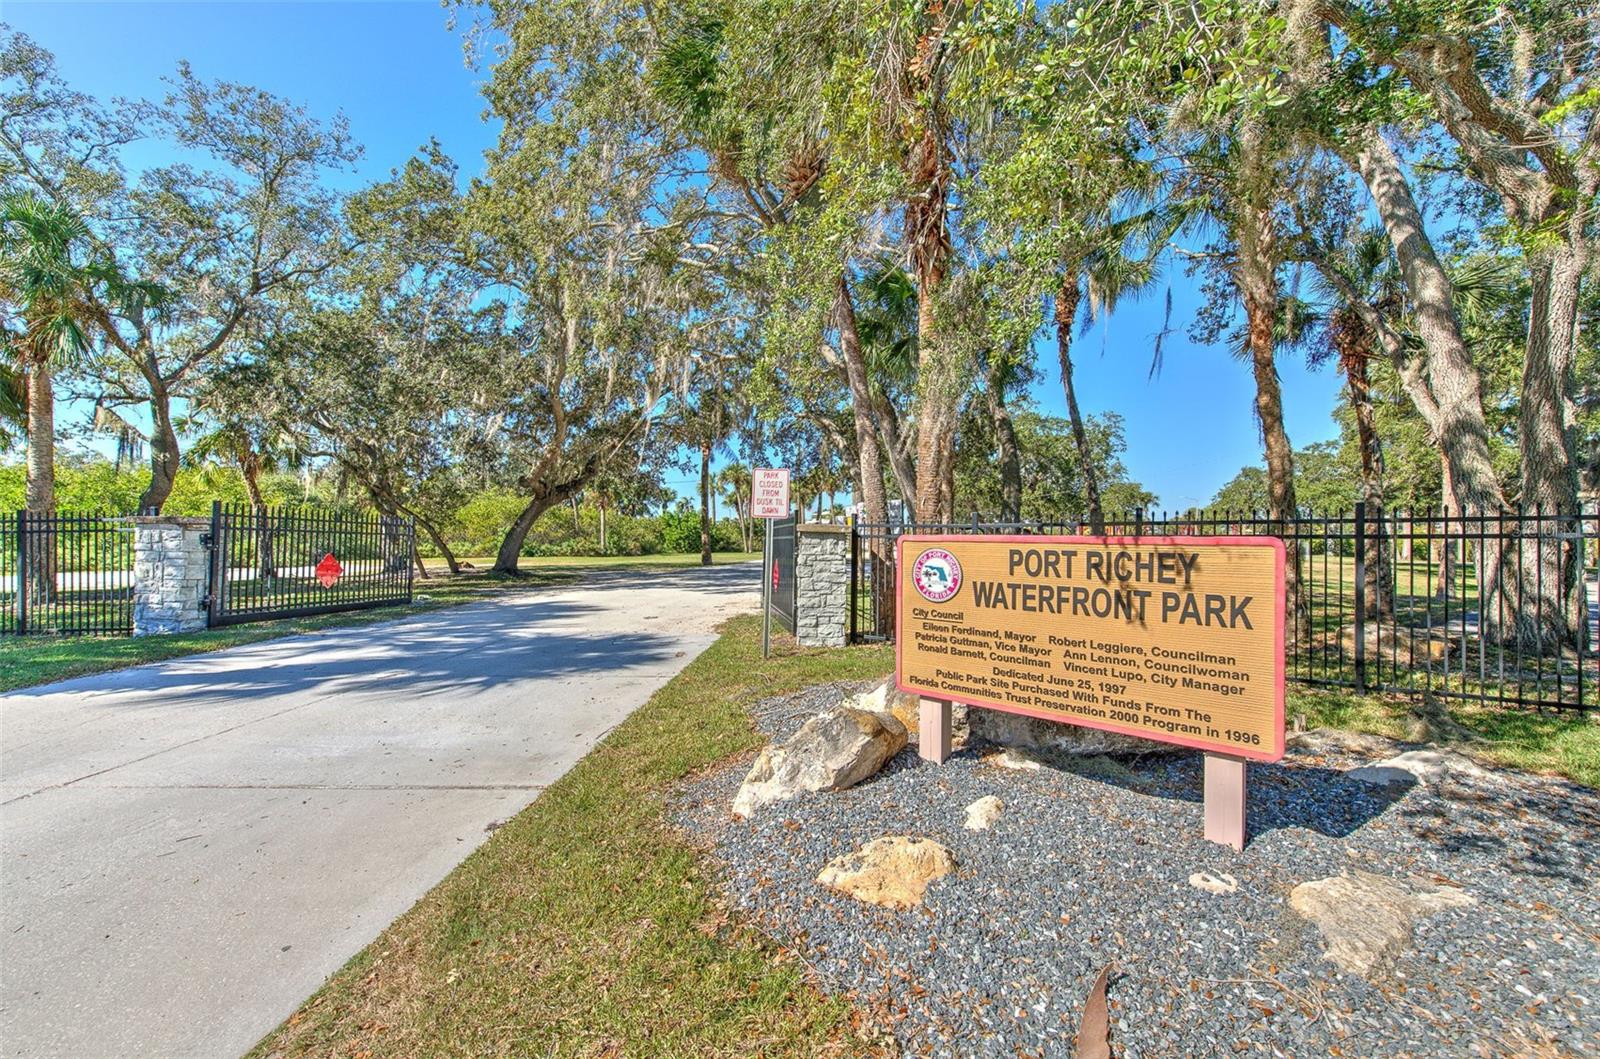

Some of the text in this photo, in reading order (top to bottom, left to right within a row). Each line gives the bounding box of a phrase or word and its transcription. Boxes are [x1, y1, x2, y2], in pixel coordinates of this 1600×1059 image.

[756, 498, 773, 506] DUSK
[762, 506, 779, 514] DAWN
[1008, 549, 1199, 584] PORT RICHEY
[922, 588, 951, 600] FLORIDA
[972, 580, 1254, 630] WATERFRONT PARK
[912, 608, 964, 620] City Council
[915, 632, 1052, 657] Patricia Guttman, Vice Mayor
[922, 622, 1036, 643] Eileen Ferdinand, Mayor
[918, 642, 1050, 668] Ronald Barnett, Councilman
[1048, 636, 1236, 666] Robert Leggiere, Councilman
[1064, 649, 1250, 682] Ann Lennon, Councilwoman
[993, 666, 1126, 695] Dedicated June 25, 1997
[1064, 661, 1245, 696] Vincent Lupo, City Manager
[936, 669, 1212, 722] Public Park Site Purchased With Funds From The
[910, 675, 1260, 746] Florida Communities Trust Preservation 2000 Program in 1996
